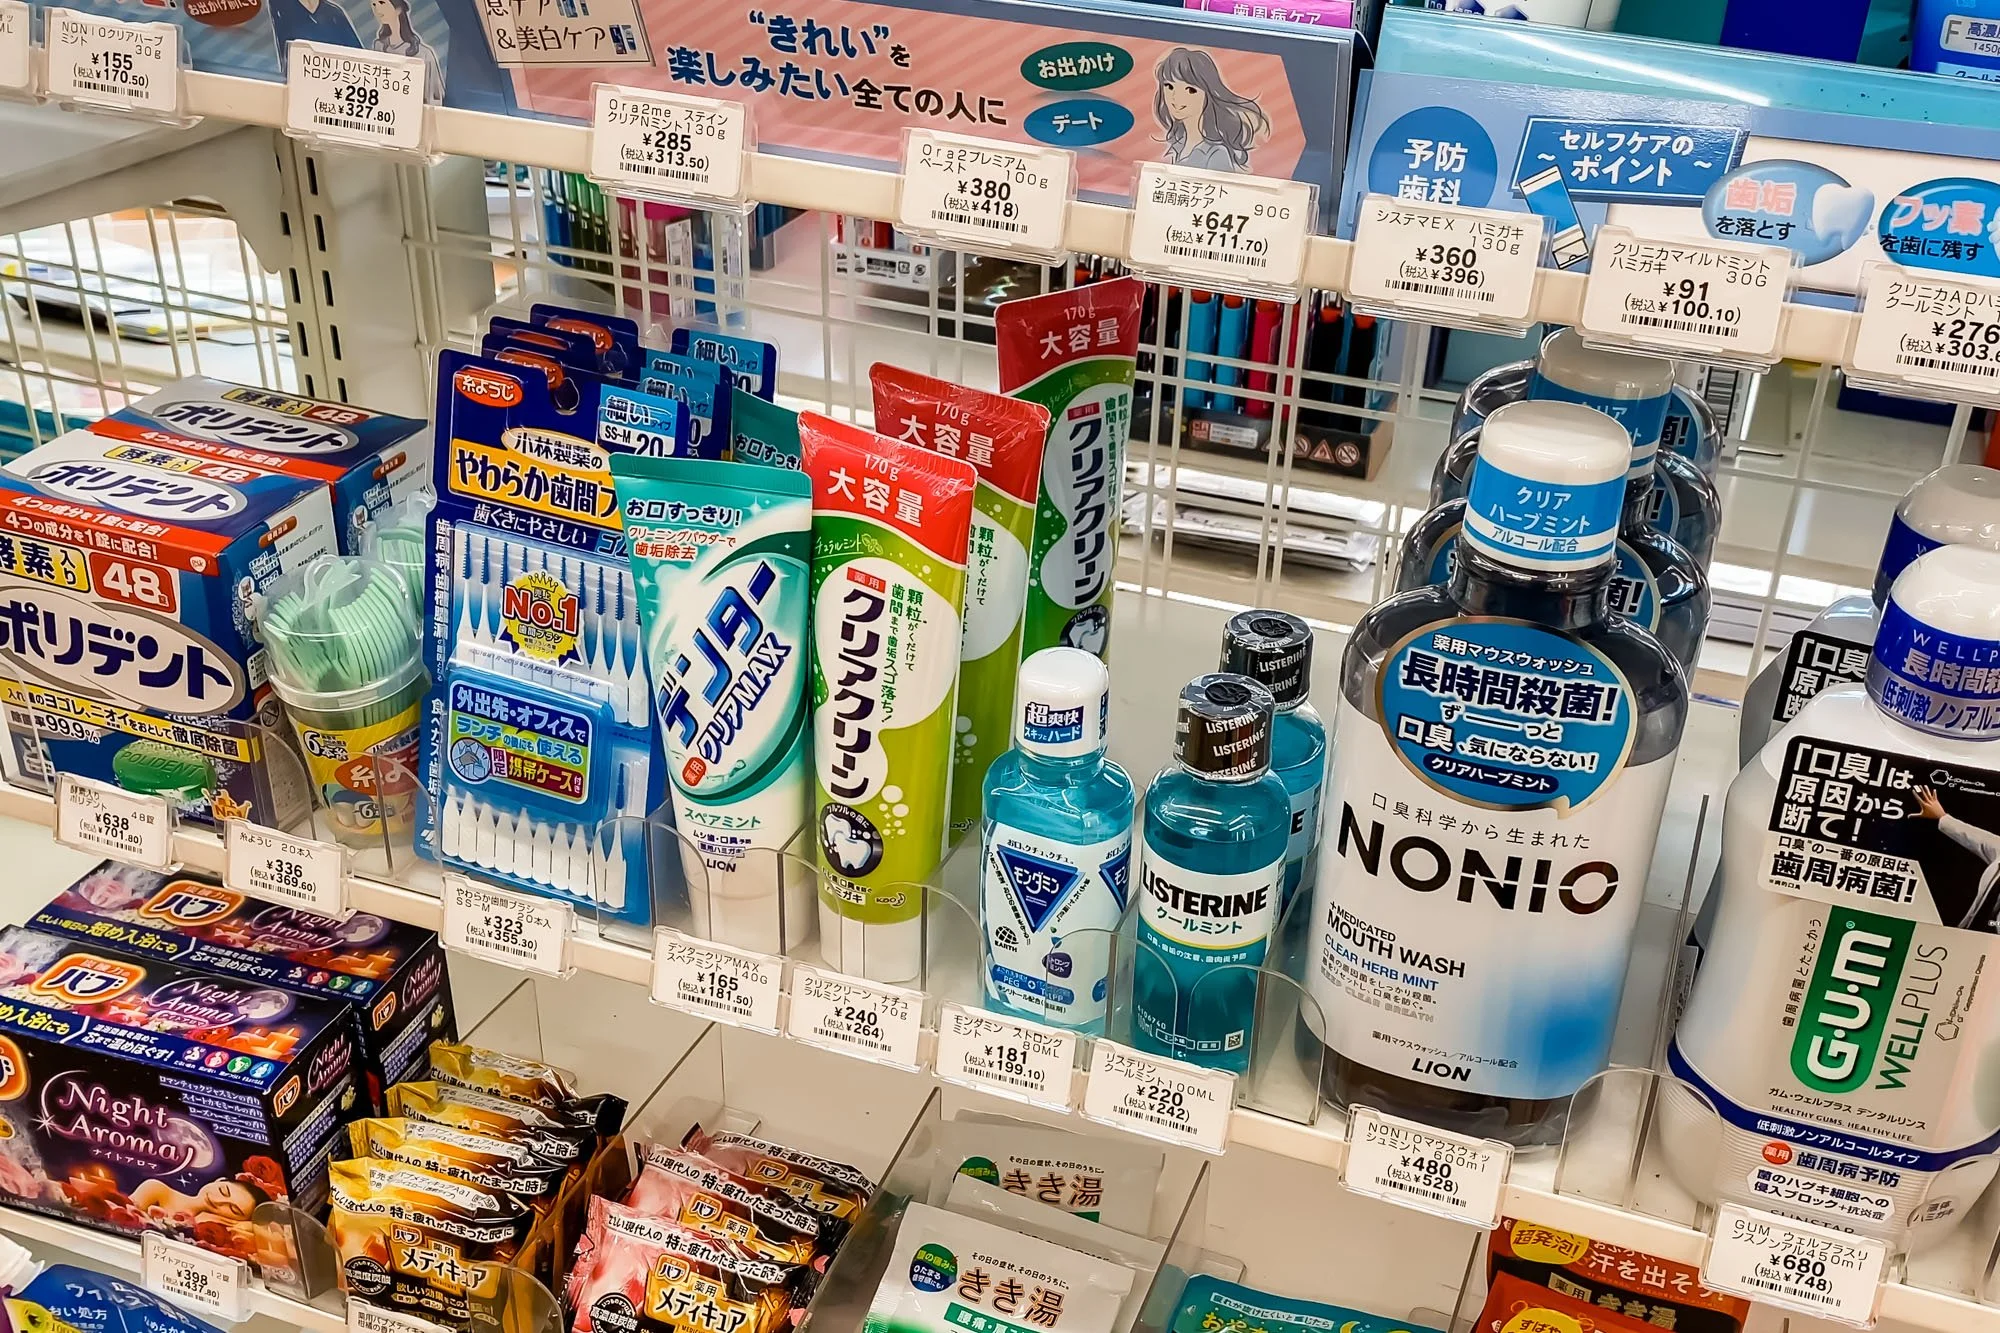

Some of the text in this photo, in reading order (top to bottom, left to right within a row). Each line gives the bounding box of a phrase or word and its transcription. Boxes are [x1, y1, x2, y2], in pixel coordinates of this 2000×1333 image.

[61, 33, 88, 46] ミント
[62, 21, 163, 47] NONIOクリアハーブ
[91, 51, 133, 71] ¥155
[1038, 52, 1115, 79] お出かけ
[334, 85, 380, 106] ¥298
[666, 46, 1008, 126] 楽しみたい全ての人に
[608, 98, 728, 126] Ora2me ステイン
[1052, 111, 1103, 134] デート
[642, 130, 692, 152] ¥285
[1559, 129, 1694, 156] セルフケアの
[921, 143, 1027, 172] Ora2プレミアム
[1404, 138, 1468, 174] 予防
[957, 178, 1011, 202] ¥380
[1154, 176, 1230, 197] シュミテクト
[1725, 178, 1797, 216] 歯垢
[943, 193, 1019, 221] (税込¥418)
[1891, 196, 1986, 237] フッ素
[1191, 211, 1250, 234] ¥647
[1376, 208, 1524, 240] システマEX ハミガキ
[1716, 215, 1795, 241] を落とす
[1415, 244, 1478, 269] ¥360
[1613, 242, 1771, 273] クリニカマイルドミント
[1880, 233, 1985, 261] を歯に残す
[1609, 259, 1768, 287] ハミガキ 30G
[1663, 278, 1710, 302] ¥91
[1886, 297, 1975, 320] クールミント
[1039, 319, 1121, 360] 大容量
[461, 375, 516, 401] 糸ようじ
[158, 405, 346, 450] ポリデント
[515, 432, 602, 470] 小林製薬の
[899, 415, 995, 469] 大容量
[38, 464, 231, 516] ポリデント
[827, 467, 924, 528] 大容量
[1517, 486, 1572, 510] クリア
[473, 504, 587, 545] 歯ぐきにやさしい
[627, 500, 742, 526] お口すっきり!
[1489, 502, 1592, 535] ハーブミント
[628, 527, 736, 547] クリーニングパウダーで
[1491, 526, 1579, 553] アルコール配合
[635, 542, 696, 561] 歯垢除去
[976, 527, 998, 606] 顆粒がくだけて
[503, 586, 579, 635] No.1
[518, 624, 562, 644] 歯間ブラシ
[905, 589, 928, 672] 顆粒がくだけて
[0, 600, 232, 700] ポリデント
[1432, 634, 1595, 677] 薬用マウスウォッシュ
[697, 632, 792, 764] クリアMAX
[830, 589, 886, 799] クリアクリーン
[1401, 650, 1620, 722] 長時間殺菌!
[457, 687, 587, 743] 外出先・オフィスで
[1027, 701, 1079, 728] 超爽快
[1431, 757, 1551, 791] クリアハーブミント
[1785, 774, 1904, 820] 原因から
[95, 812, 130, 831] ¥638
[684, 807, 761, 829] スペアミント
[1372, 792, 1591, 850] 口臭科学から生まれた
[1779, 803, 1863, 842] 断て!
[239, 832, 273, 848] 糸ようじ
[265, 859, 303, 878] ¥336
[707, 858, 737, 872] LION
[1337, 801, 1619, 915] NONIO
[1013, 866, 1059, 894] モンダミン
[1143, 861, 1271, 917] LISTERINE
[1771, 851, 1918, 903] 歯周病菌!
[154, 898, 229, 917] バブ
[456, 887, 535, 914] やわらか歯間ブラシ
[484, 915, 523, 936] ¥323
[517, 912, 552, 929] 20本入
[1156, 906, 1242, 934] クールミント
[667, 941, 760, 973] デンタークリアMAX
[995, 940, 1018, 953] EARTH
[1327, 908, 1466, 978] MOUTH WASH
[666, 951, 722, 972] スペアミント
[1325, 933, 1358, 965] CLEAR
[1361, 958, 1399, 981] HERB
[1402, 973, 1439, 991] MINT
[1782, 918, 1822, 1028] 歯周病菌とたたかう
[48, 968, 126, 994] バブ
[177, 980, 251, 1007] Night
[697, 972, 738, 992] ¥165
[156, 995, 233, 1022] Aroma
[834, 1006, 878, 1027] ¥240
[822, 1015, 885, 1041] (税込¥264)
[953, 1014, 1063, 1048] モンダミン ストロング
[953, 1024, 983, 1039] ミント
[984, 1045, 1027, 1065] ¥181
[1106, 1053, 1156, 1073] リステリン
[1104, 1062, 1216, 1102] クールミント100ML
[1412, 1058, 1472, 1082] LION
[59, 1081, 169, 1129] Night
[1124, 1093, 1190, 1122] (税込¥242)
[1136, 1085, 1184, 1108] ¥220
[1769, 1087, 1926, 1131] ガム・ウェルプラス デンタルリンス
[70, 1114, 181, 1163] Aroma
[1368, 1121, 1490, 1163] NONIOマウスウォッ
[1756, 1118, 1920, 1165] 低刺激ノンアルコールタイプ
[93, 1149, 158, 1170] ナイトアロマ
[1401, 1156, 1452, 1180] ¥480
[1763, 1144, 1901, 1188] 薬用 歯周病予防
[1387, 1164, 1459, 1195] (税込¥528)
[1756, 1169, 1889, 1208] 菌のハグキ細胞への
[727, 1219, 749, 1236] 薬用
[1734, 1219, 1868, 1261] GUM ウェルプラスリ
[433, 1242, 454, 1257] 薬用
[1513, 1229, 1580, 1258] 超発泡!
[177, 1269, 208, 1286] ¥398
[402, 1249, 487, 1289] メディキュア
[1754, 1262, 1834, 1295] (税込¥748)
[1769, 1253, 1826, 1278] ¥680
[694, 1280, 717, 1297] 薬用
[958, 1266, 1067, 1328] きき湯
[654, 1287, 746, 1333] メディキュア
